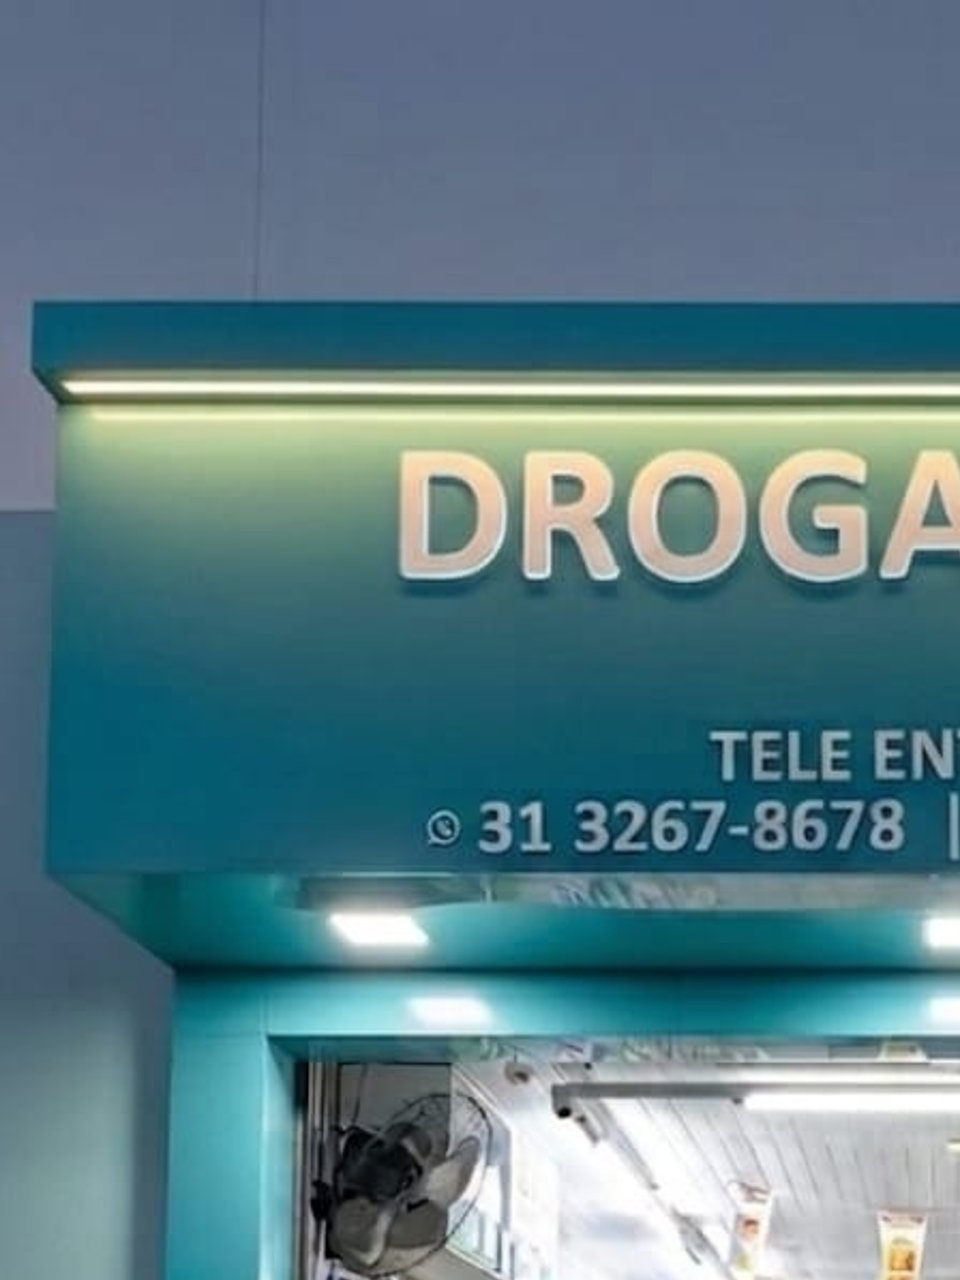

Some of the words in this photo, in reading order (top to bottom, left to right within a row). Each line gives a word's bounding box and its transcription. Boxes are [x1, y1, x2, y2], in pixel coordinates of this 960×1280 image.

[709, 729, 852, 782] TELE
[478, 799, 552, 854] 31
[574, 798, 906, 854] 3267-8678
